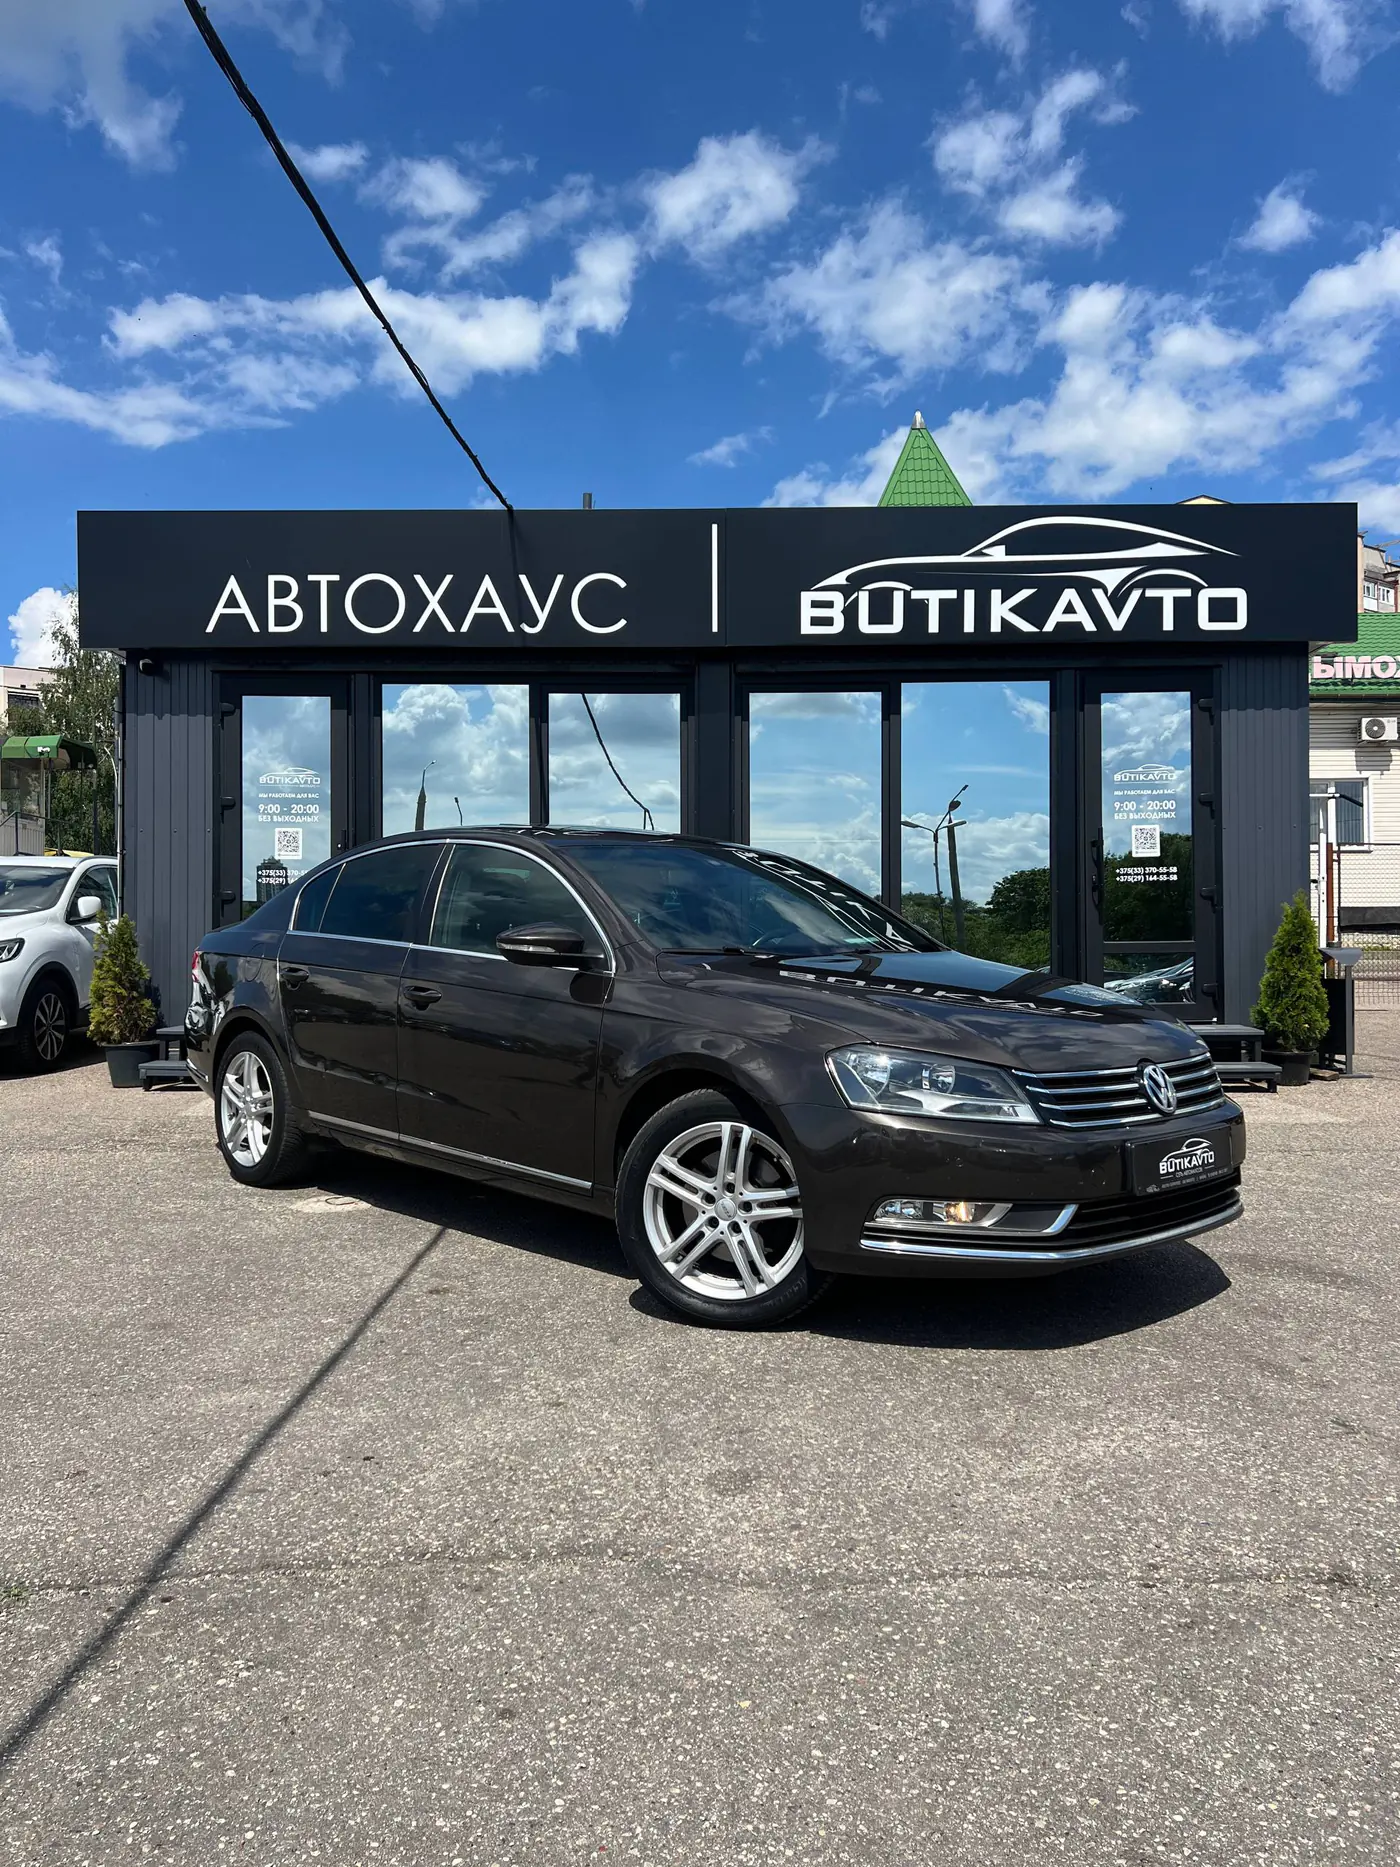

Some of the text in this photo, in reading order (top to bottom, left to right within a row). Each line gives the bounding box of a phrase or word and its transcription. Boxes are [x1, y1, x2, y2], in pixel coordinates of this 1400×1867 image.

[205, 572, 628, 634] АВТОХАУС
[799, 586, 1248, 635] BUTIKAVTO
[259, 775, 321, 785] BUTIKAVTO
[1114, 773, 1177, 782] BUTIKAVTO
[258, 804, 280, 814] 9:00
[291, 804, 320, 814] 20:00
[1114, 801, 1136, 811] 9:00
[1147, 800, 1176, 810] 20:00
[273, 815, 319, 823] ВЫХОДНЫХ
[257, 869, 286, 877] +375(33)
[1115, 866, 1178, 875] +375(33) 370-55-58
[257, 877, 286, 885] +375(29)
[1145, 874, 1178, 882] 164-55-58
[1159, 1151, 1215, 1175] BUTIKAVTO
